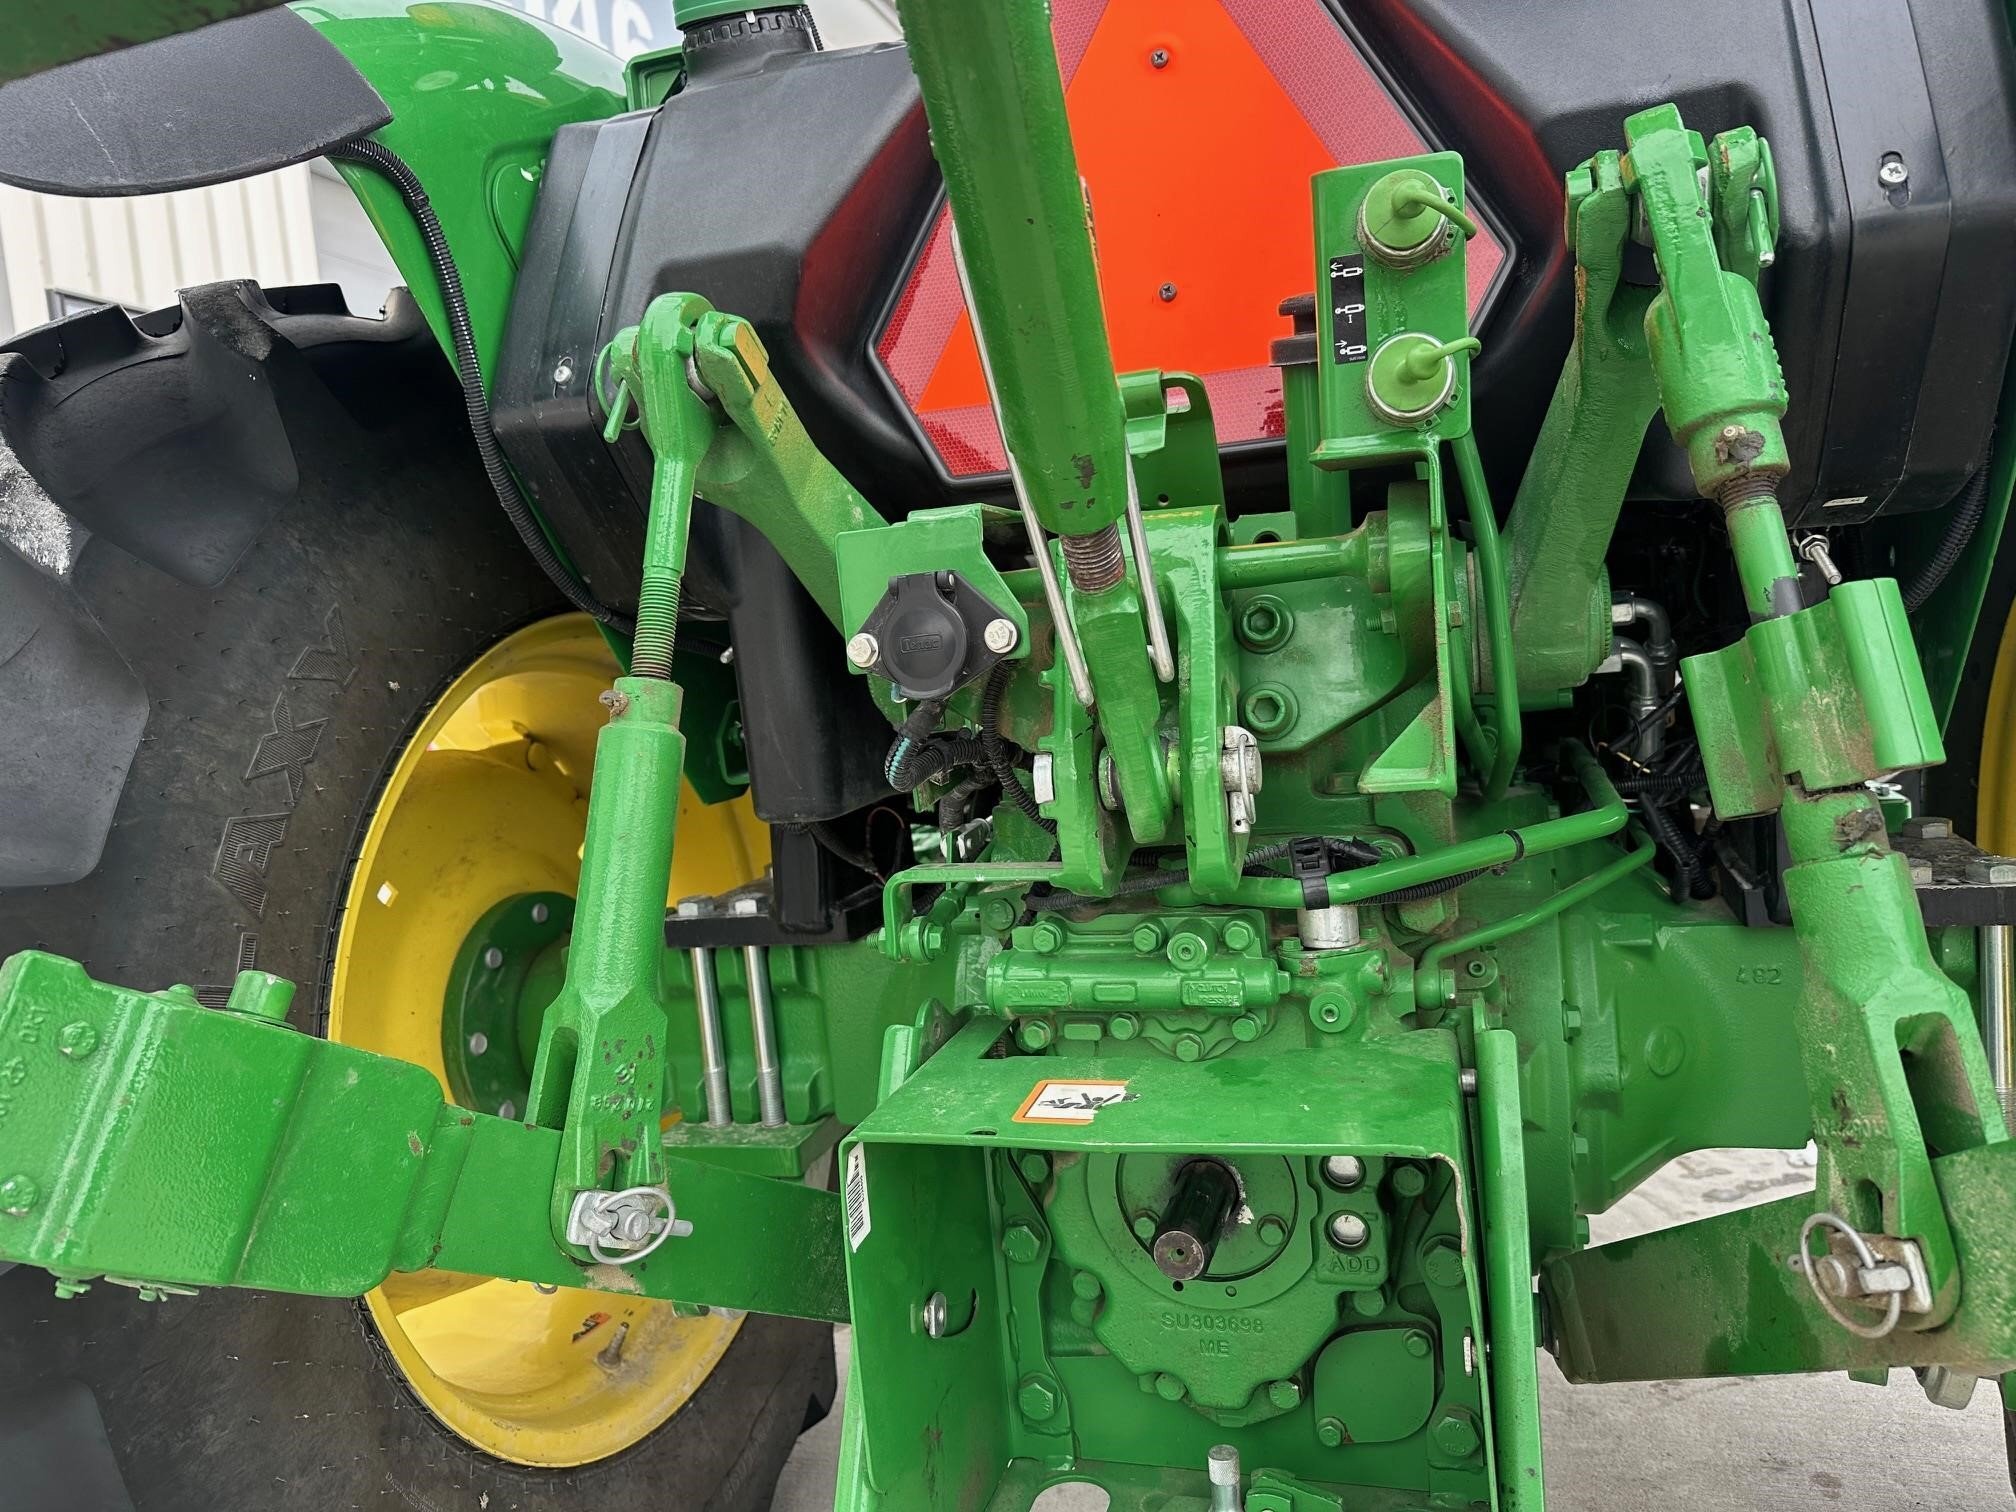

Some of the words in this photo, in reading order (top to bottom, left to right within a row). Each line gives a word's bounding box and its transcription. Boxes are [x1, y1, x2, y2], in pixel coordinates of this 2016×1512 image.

[1331, 1255, 1380, 1273] ADD
[1160, 1312, 1265, 1335] SU303698
[1199, 1338, 1232, 1357] ME
